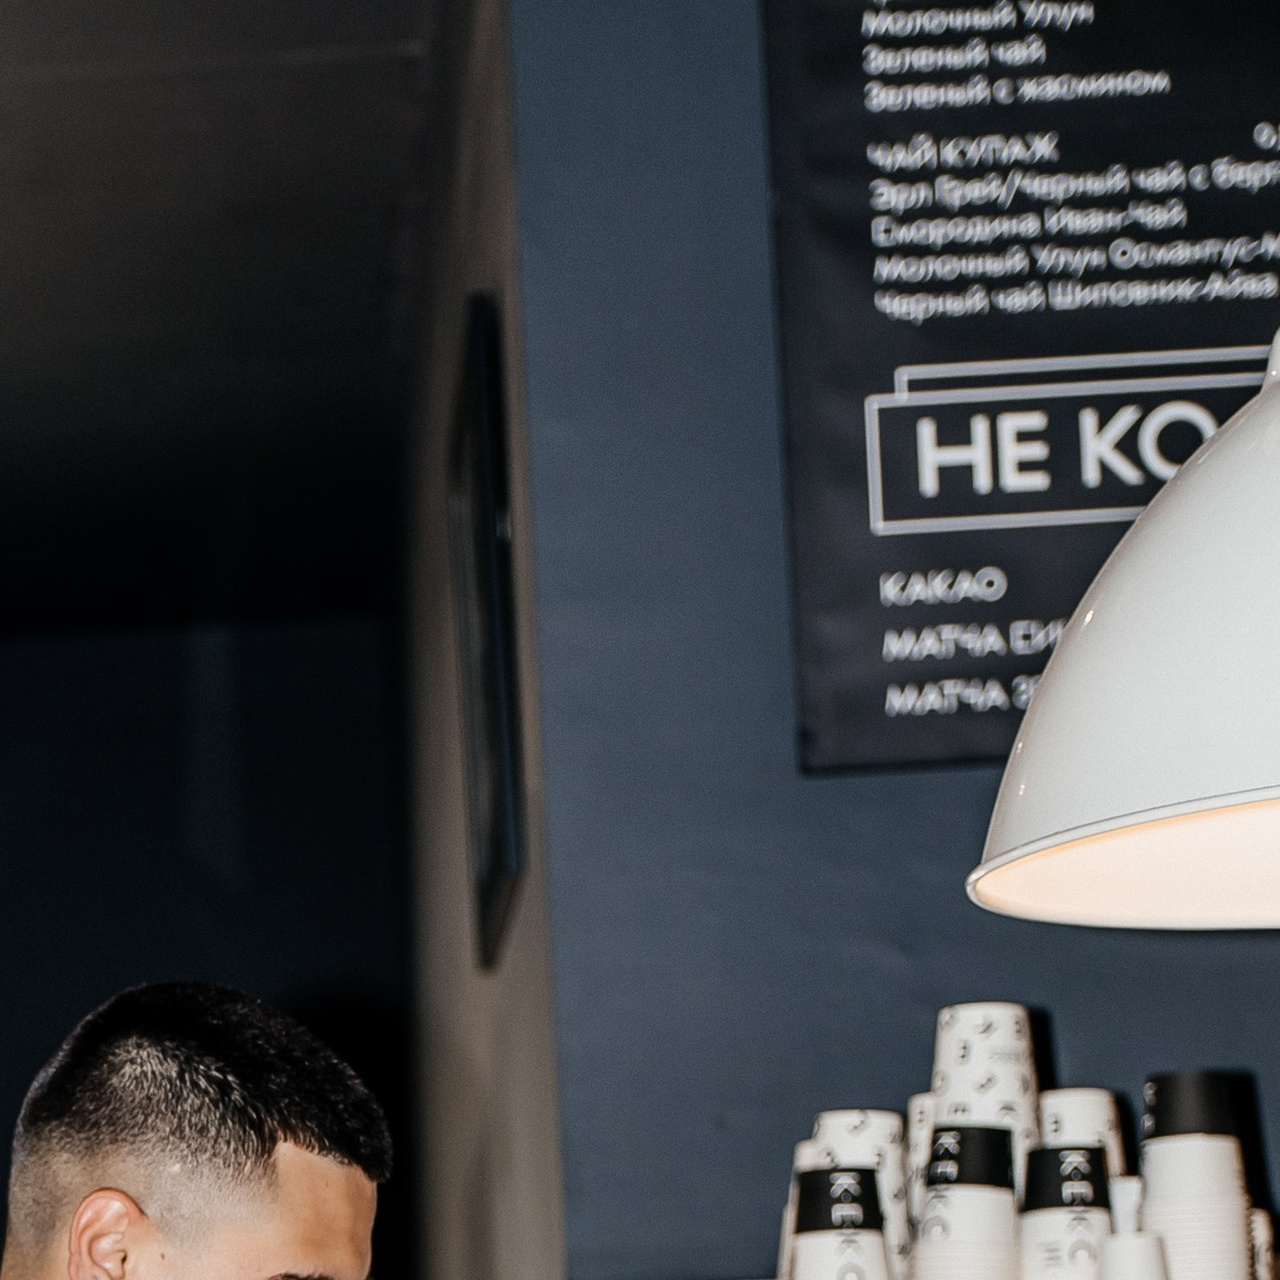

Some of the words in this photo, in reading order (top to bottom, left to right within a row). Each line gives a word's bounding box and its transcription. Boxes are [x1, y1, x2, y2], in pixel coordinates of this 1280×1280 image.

[916, 409, 1051, 498] НЕ
[879, 566, 1008, 607] КАКАО
[882, 622, 1008, 662] МАТЧА
[884, 678, 1011, 717] МАТЧА
